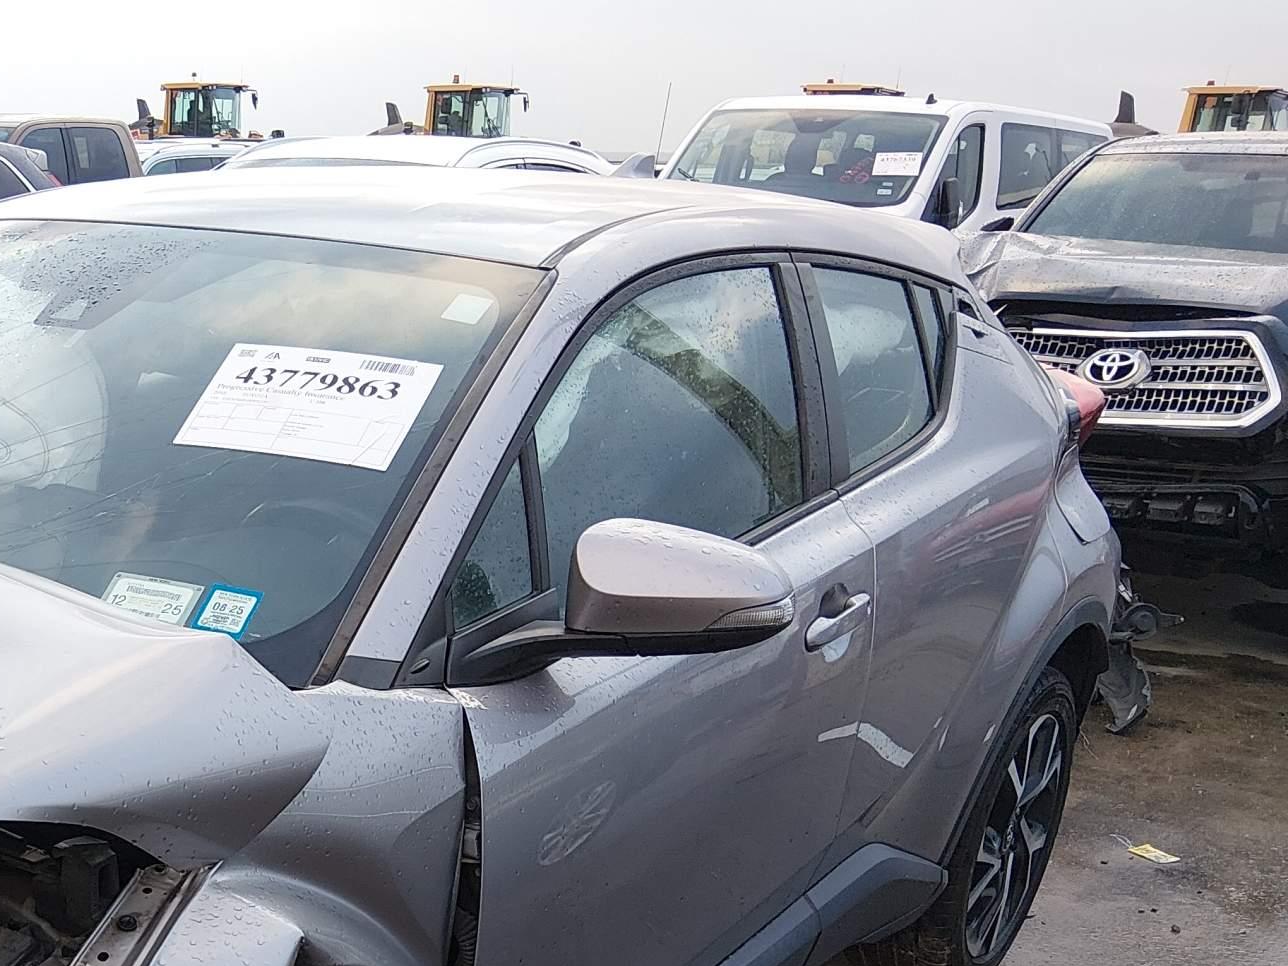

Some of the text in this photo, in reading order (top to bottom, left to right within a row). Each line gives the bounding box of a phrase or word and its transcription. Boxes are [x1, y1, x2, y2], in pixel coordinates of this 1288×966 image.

[235, 366, 401, 400] 43779863
[111, 593, 126, 606] 12
[161, 603, 183, 616] 25
